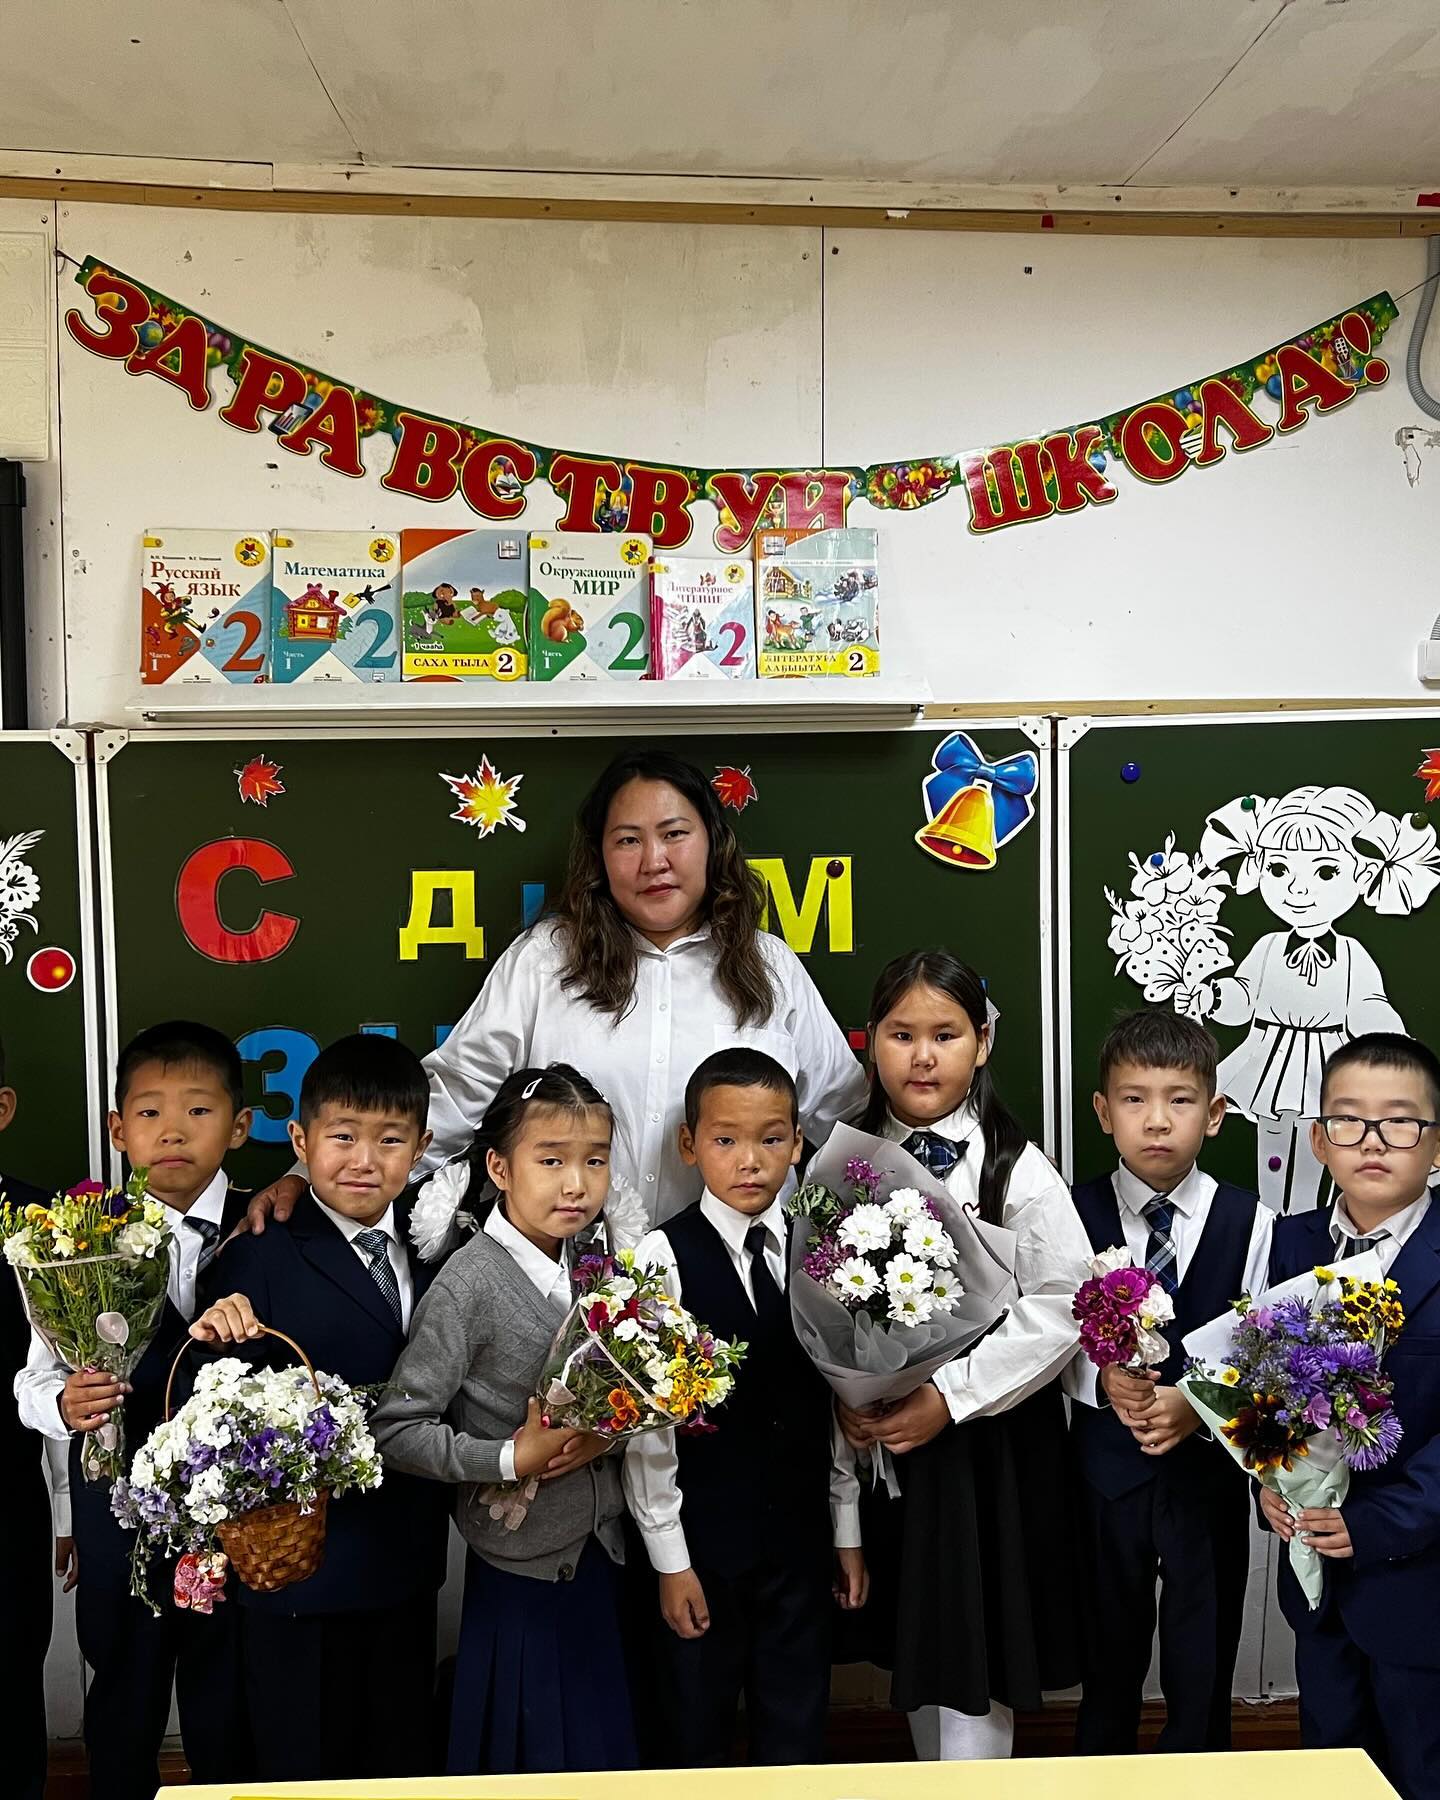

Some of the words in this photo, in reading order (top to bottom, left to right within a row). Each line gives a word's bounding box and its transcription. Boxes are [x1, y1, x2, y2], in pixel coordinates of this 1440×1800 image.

[65, 271, 850, 555] ЗДРАВСТВУЙ
[965, 311, 1391, 533] ШКОЛА!
[150, 561, 221, 582] Русский
[284, 561, 386, 578] Математика
[539, 561, 636, 580] Окружающий
[186, 582, 241, 597] ЯЗЫК
[572, 580, 621, 596] МИР
[221, 610, 266, 672] 2
[353, 608, 398, 669] 2
[608, 611, 649, 671] 2
[718, 621, 747, 667] 2
[151, 659, 159, 672] 1
[284, 658, 292, 670] 1
[413, 657, 449, 668] САХА
[453, 658, 489, 668] ТЫЛА
[498, 653, 513, 673] 2
[543, 657, 552, 669] 1
[849, 652, 864, 672] 2
[175, 836, 301, 964] С
